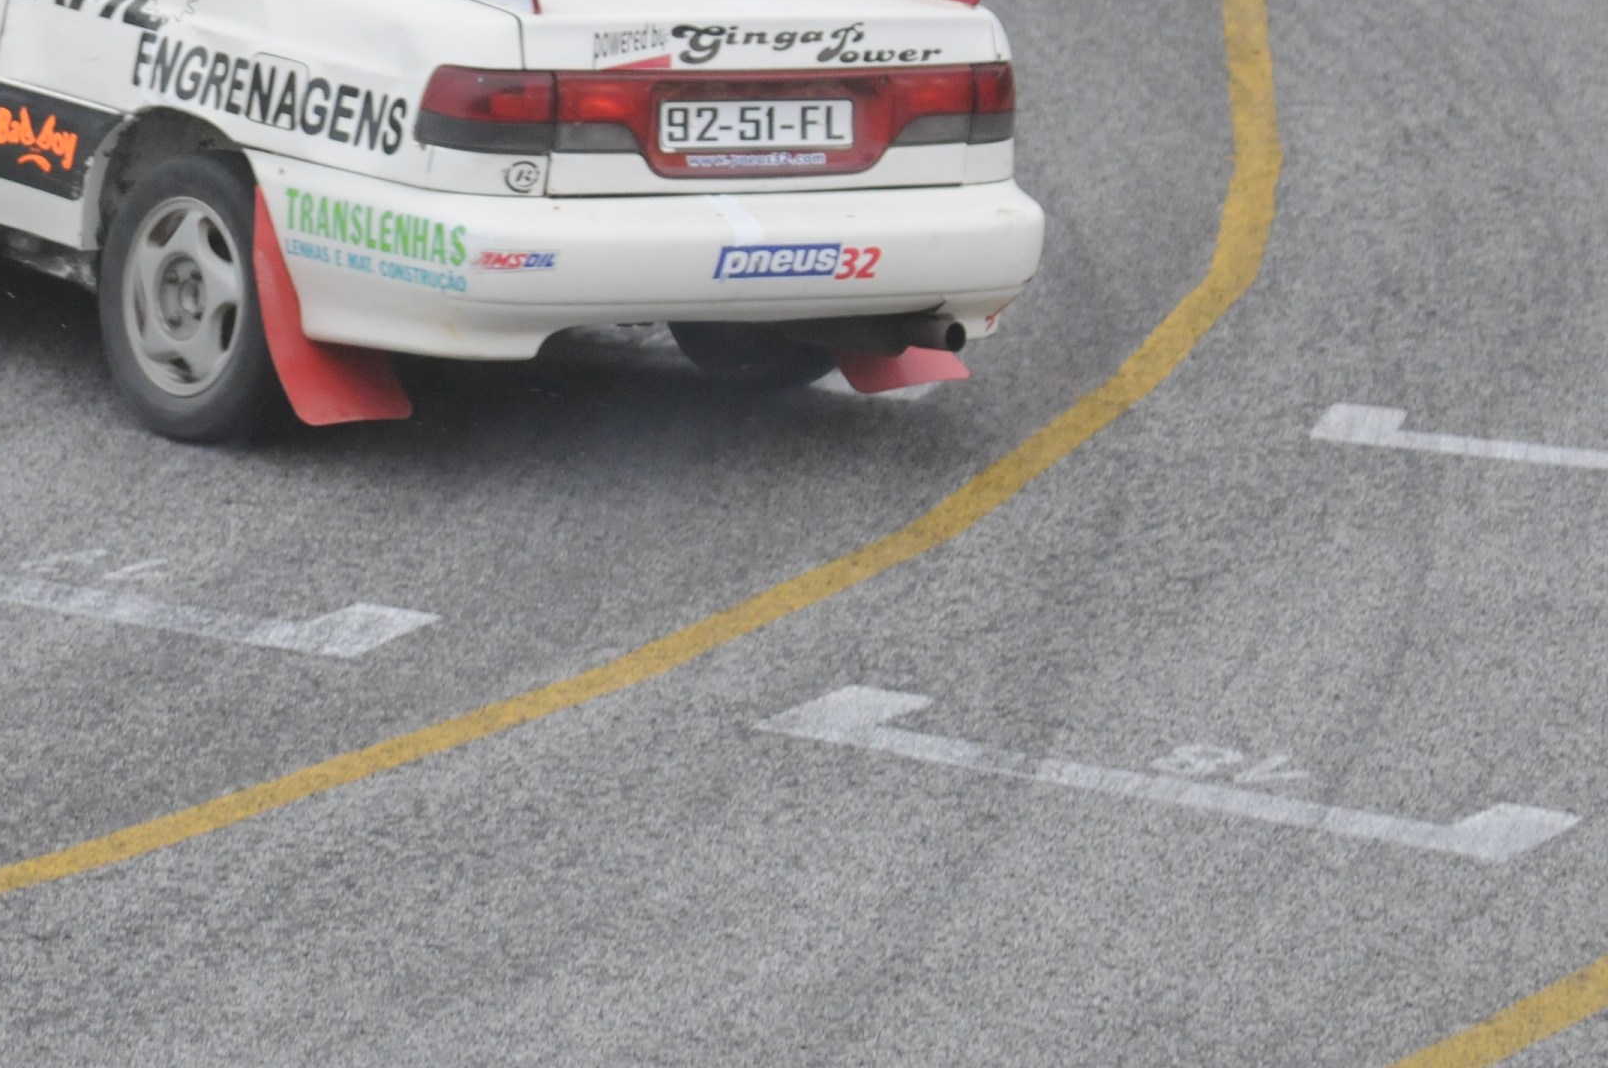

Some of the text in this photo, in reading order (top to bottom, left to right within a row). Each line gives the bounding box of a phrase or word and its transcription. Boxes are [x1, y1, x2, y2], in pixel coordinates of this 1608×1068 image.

[671, 24, 825, 65] Ginga
[132, 32, 408, 156] ENGRENAGENS
[667, 105, 845, 142] 92-51-FL
[285, 187, 467, 267] TRANSLENHAS
[286, 237, 330, 263] LENHAS
